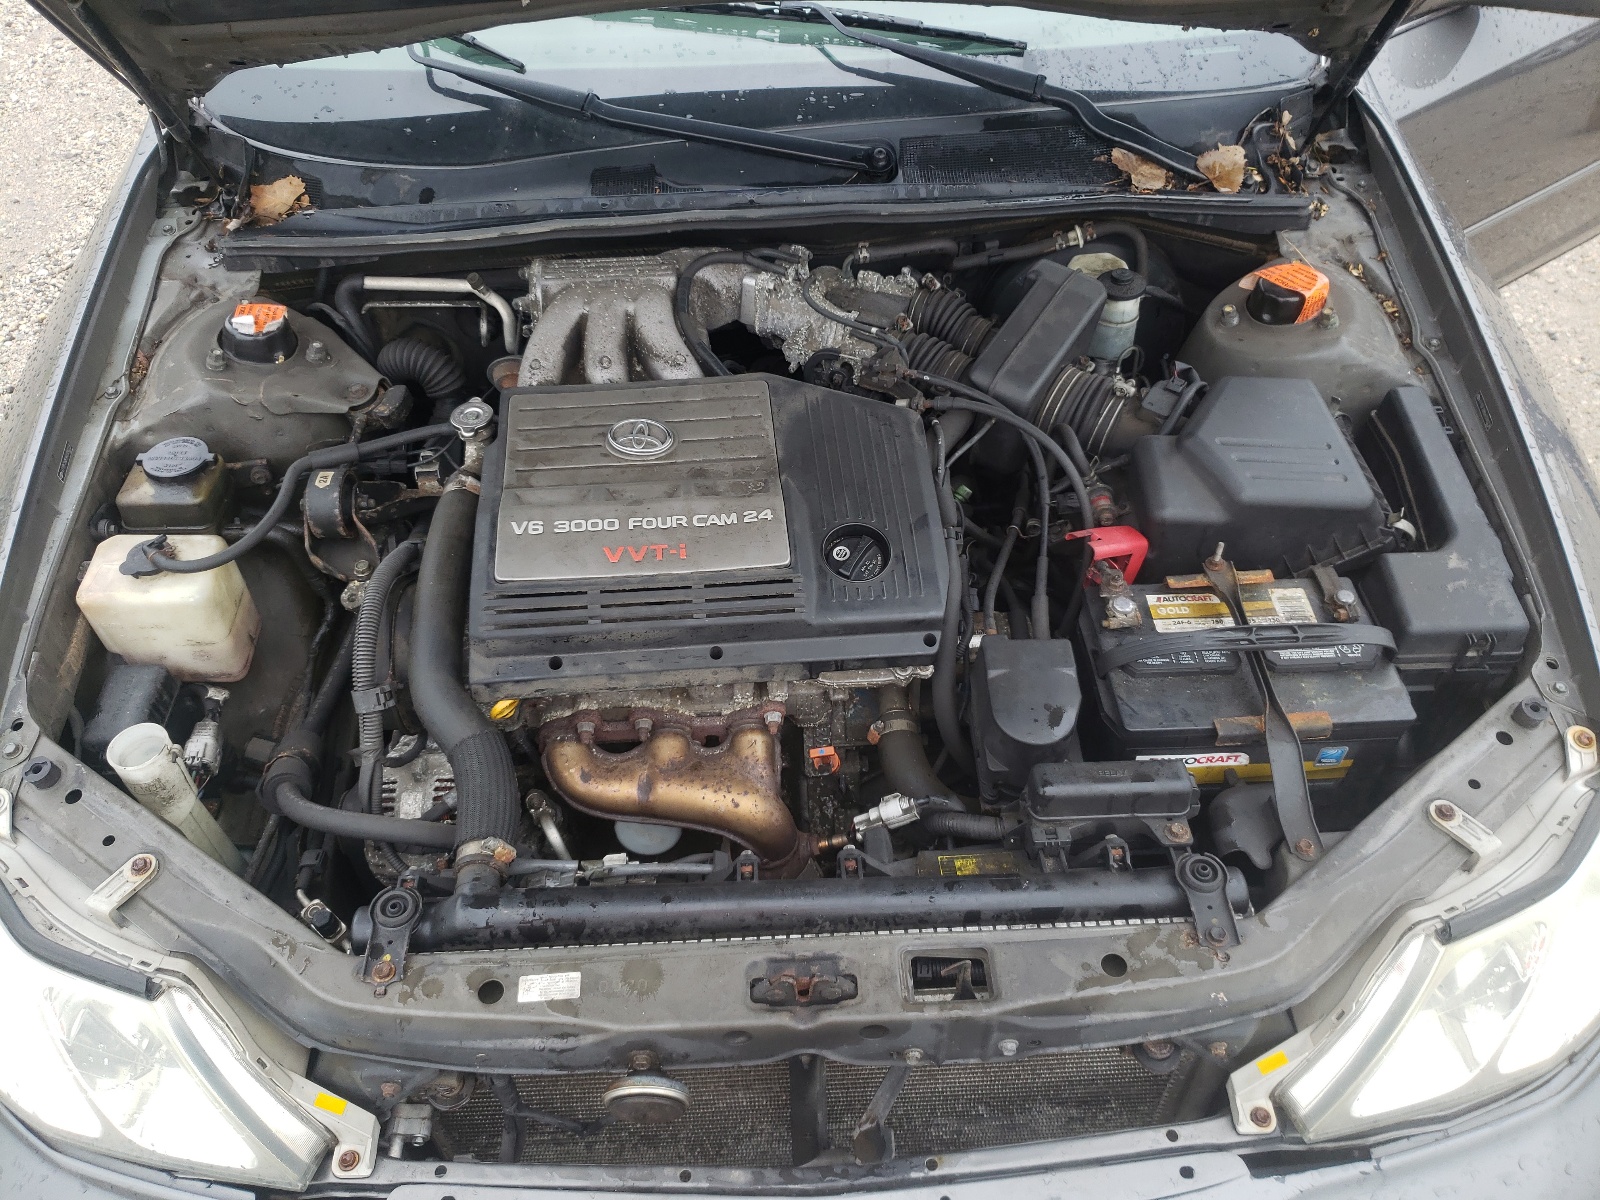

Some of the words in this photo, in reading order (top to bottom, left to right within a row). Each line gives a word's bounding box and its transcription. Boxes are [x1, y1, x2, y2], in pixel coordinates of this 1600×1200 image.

[510, 520, 545, 535] V6
[553, 518, 620, 533] 3000
[628, 515, 689, 530] FOUR
[692, 512, 738, 527] CAM
[742, 508, 774, 523] 24
[602, 543, 687, 563] VVT-i
[1157, 606, 1190, 615] GOLD
[1162, 754, 1242, 764] OCRAFT
